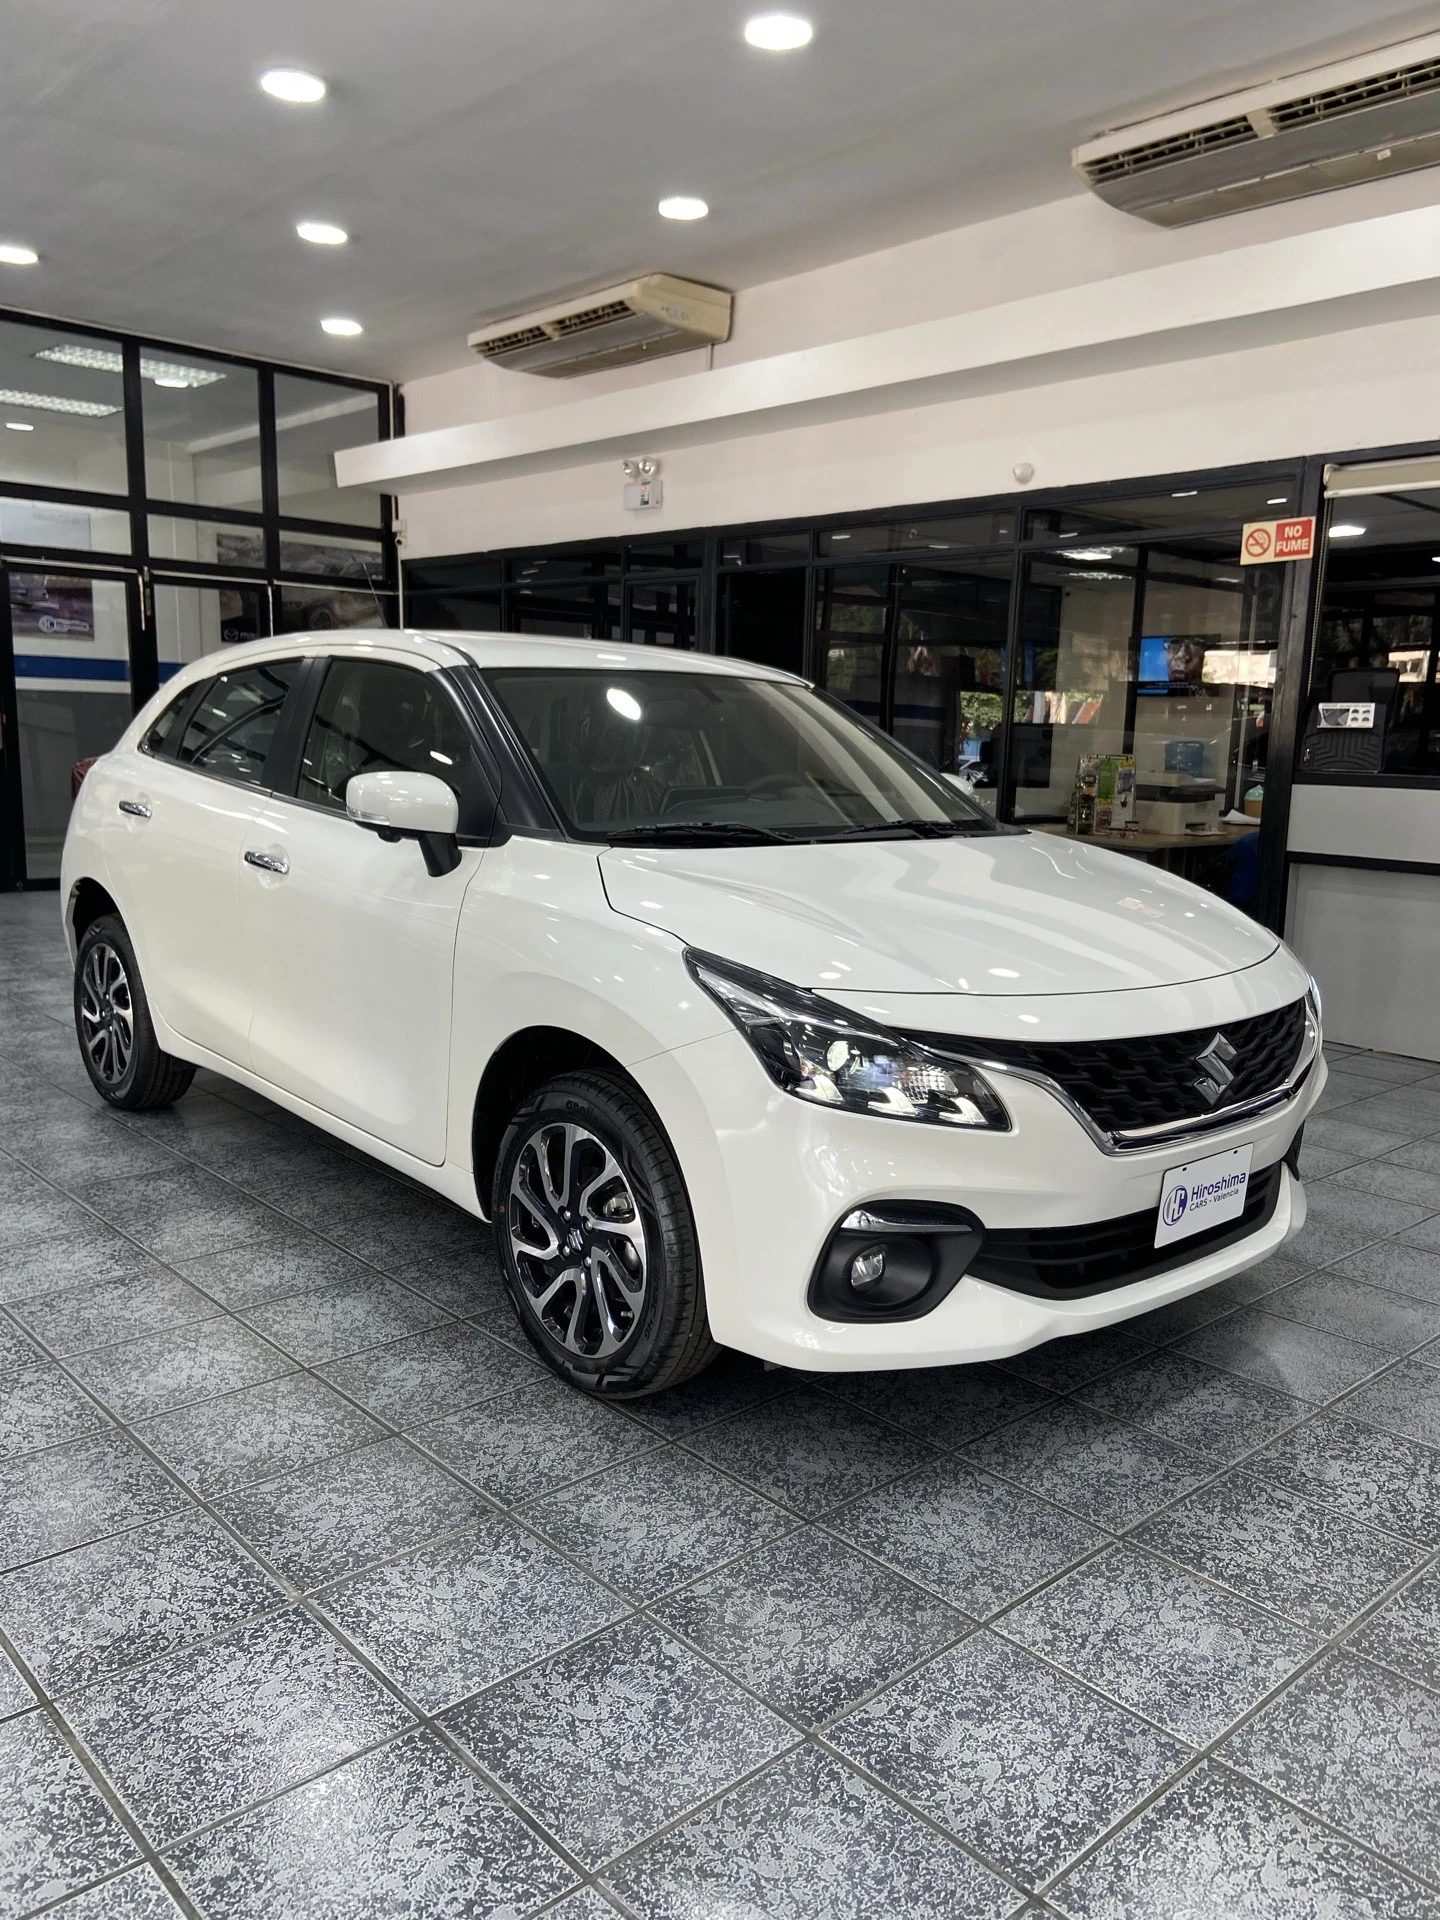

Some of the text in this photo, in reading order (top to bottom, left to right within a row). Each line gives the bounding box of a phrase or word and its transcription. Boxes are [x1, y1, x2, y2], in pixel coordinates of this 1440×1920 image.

[1284, 525, 1303, 538] NO
[1276, 538, 1309, 553] FUME
[1190, 1172, 1246, 1202] Hiroshima
[1189, 1198, 1208, 1212] CARS
[1213, 1188, 1239, 1203] Valencia
